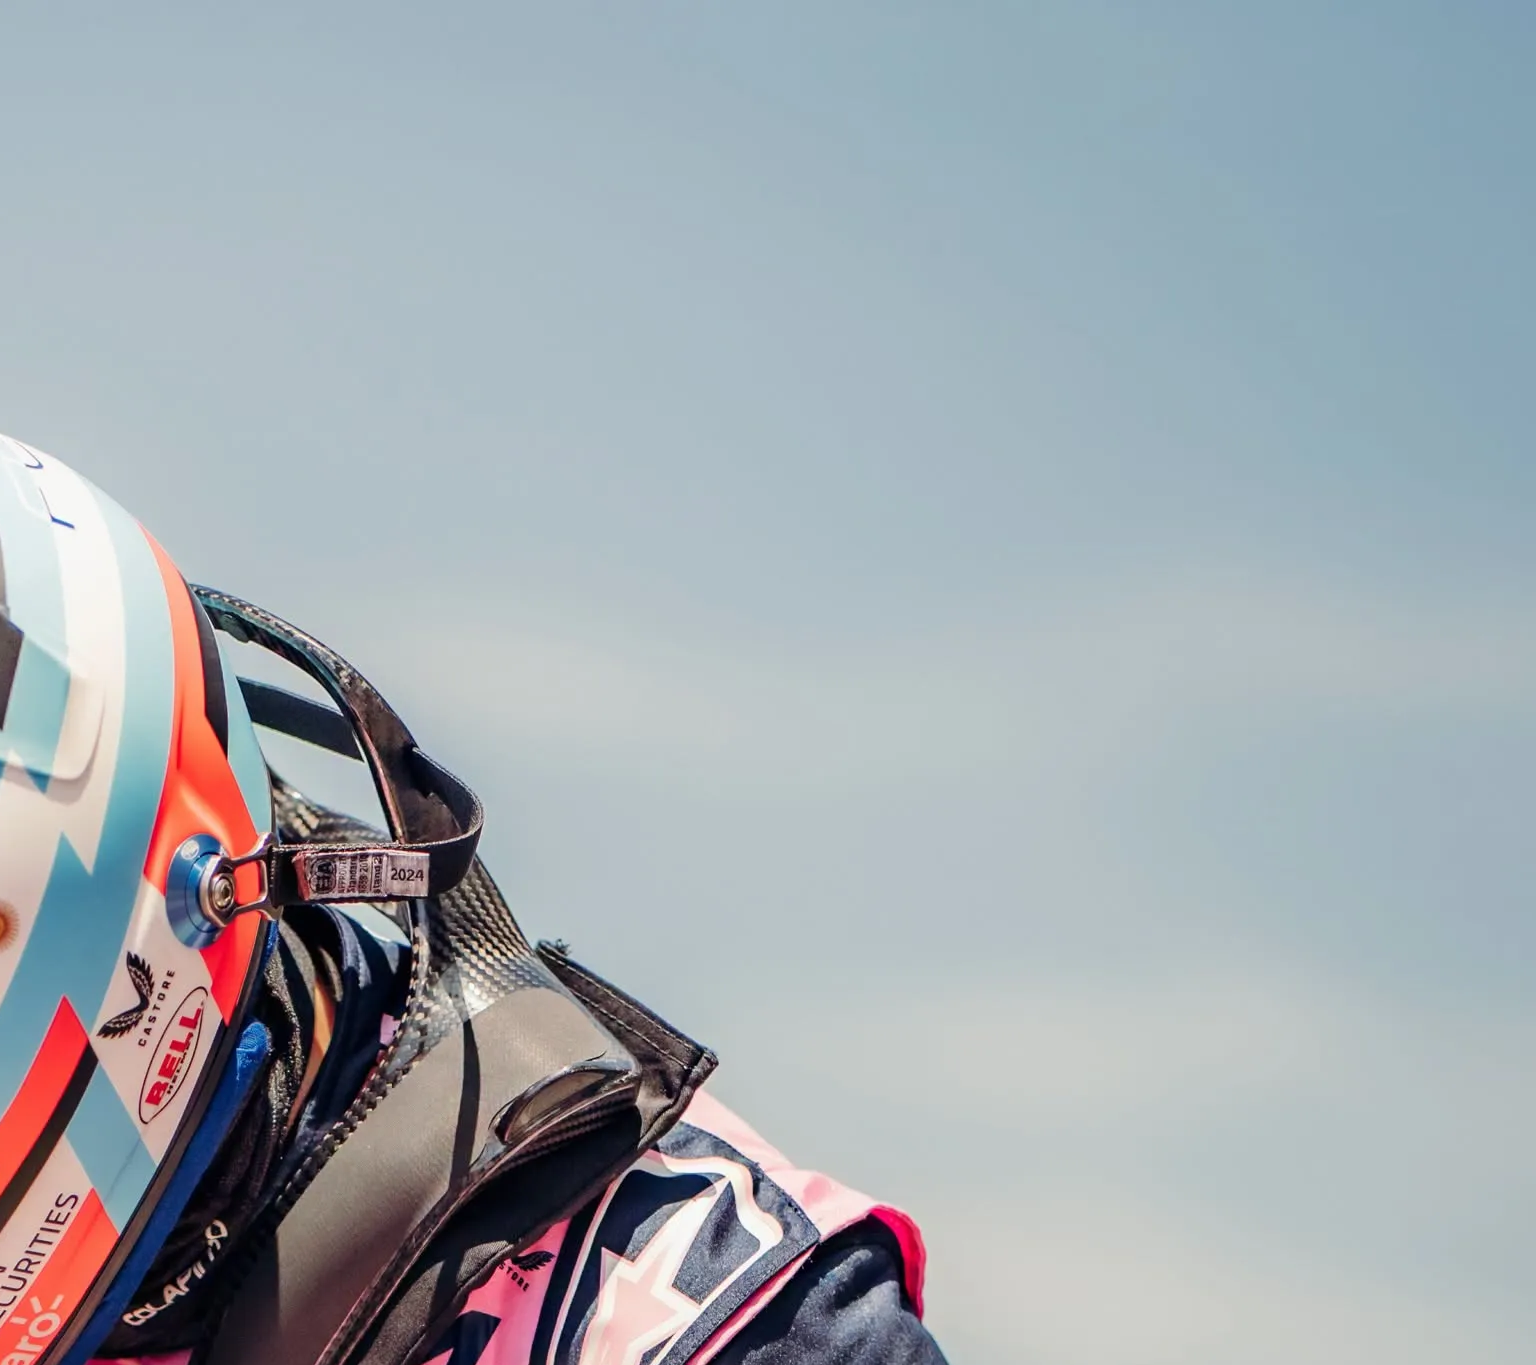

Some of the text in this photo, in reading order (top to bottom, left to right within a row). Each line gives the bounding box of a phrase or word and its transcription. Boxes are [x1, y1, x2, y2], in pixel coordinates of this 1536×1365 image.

[390, 868, 425, 882] 2024
[137, 969, 176, 1048] CASTORE
[145, 1007, 202, 1106] BELL
[498, 1261, 530, 1293] STORE
